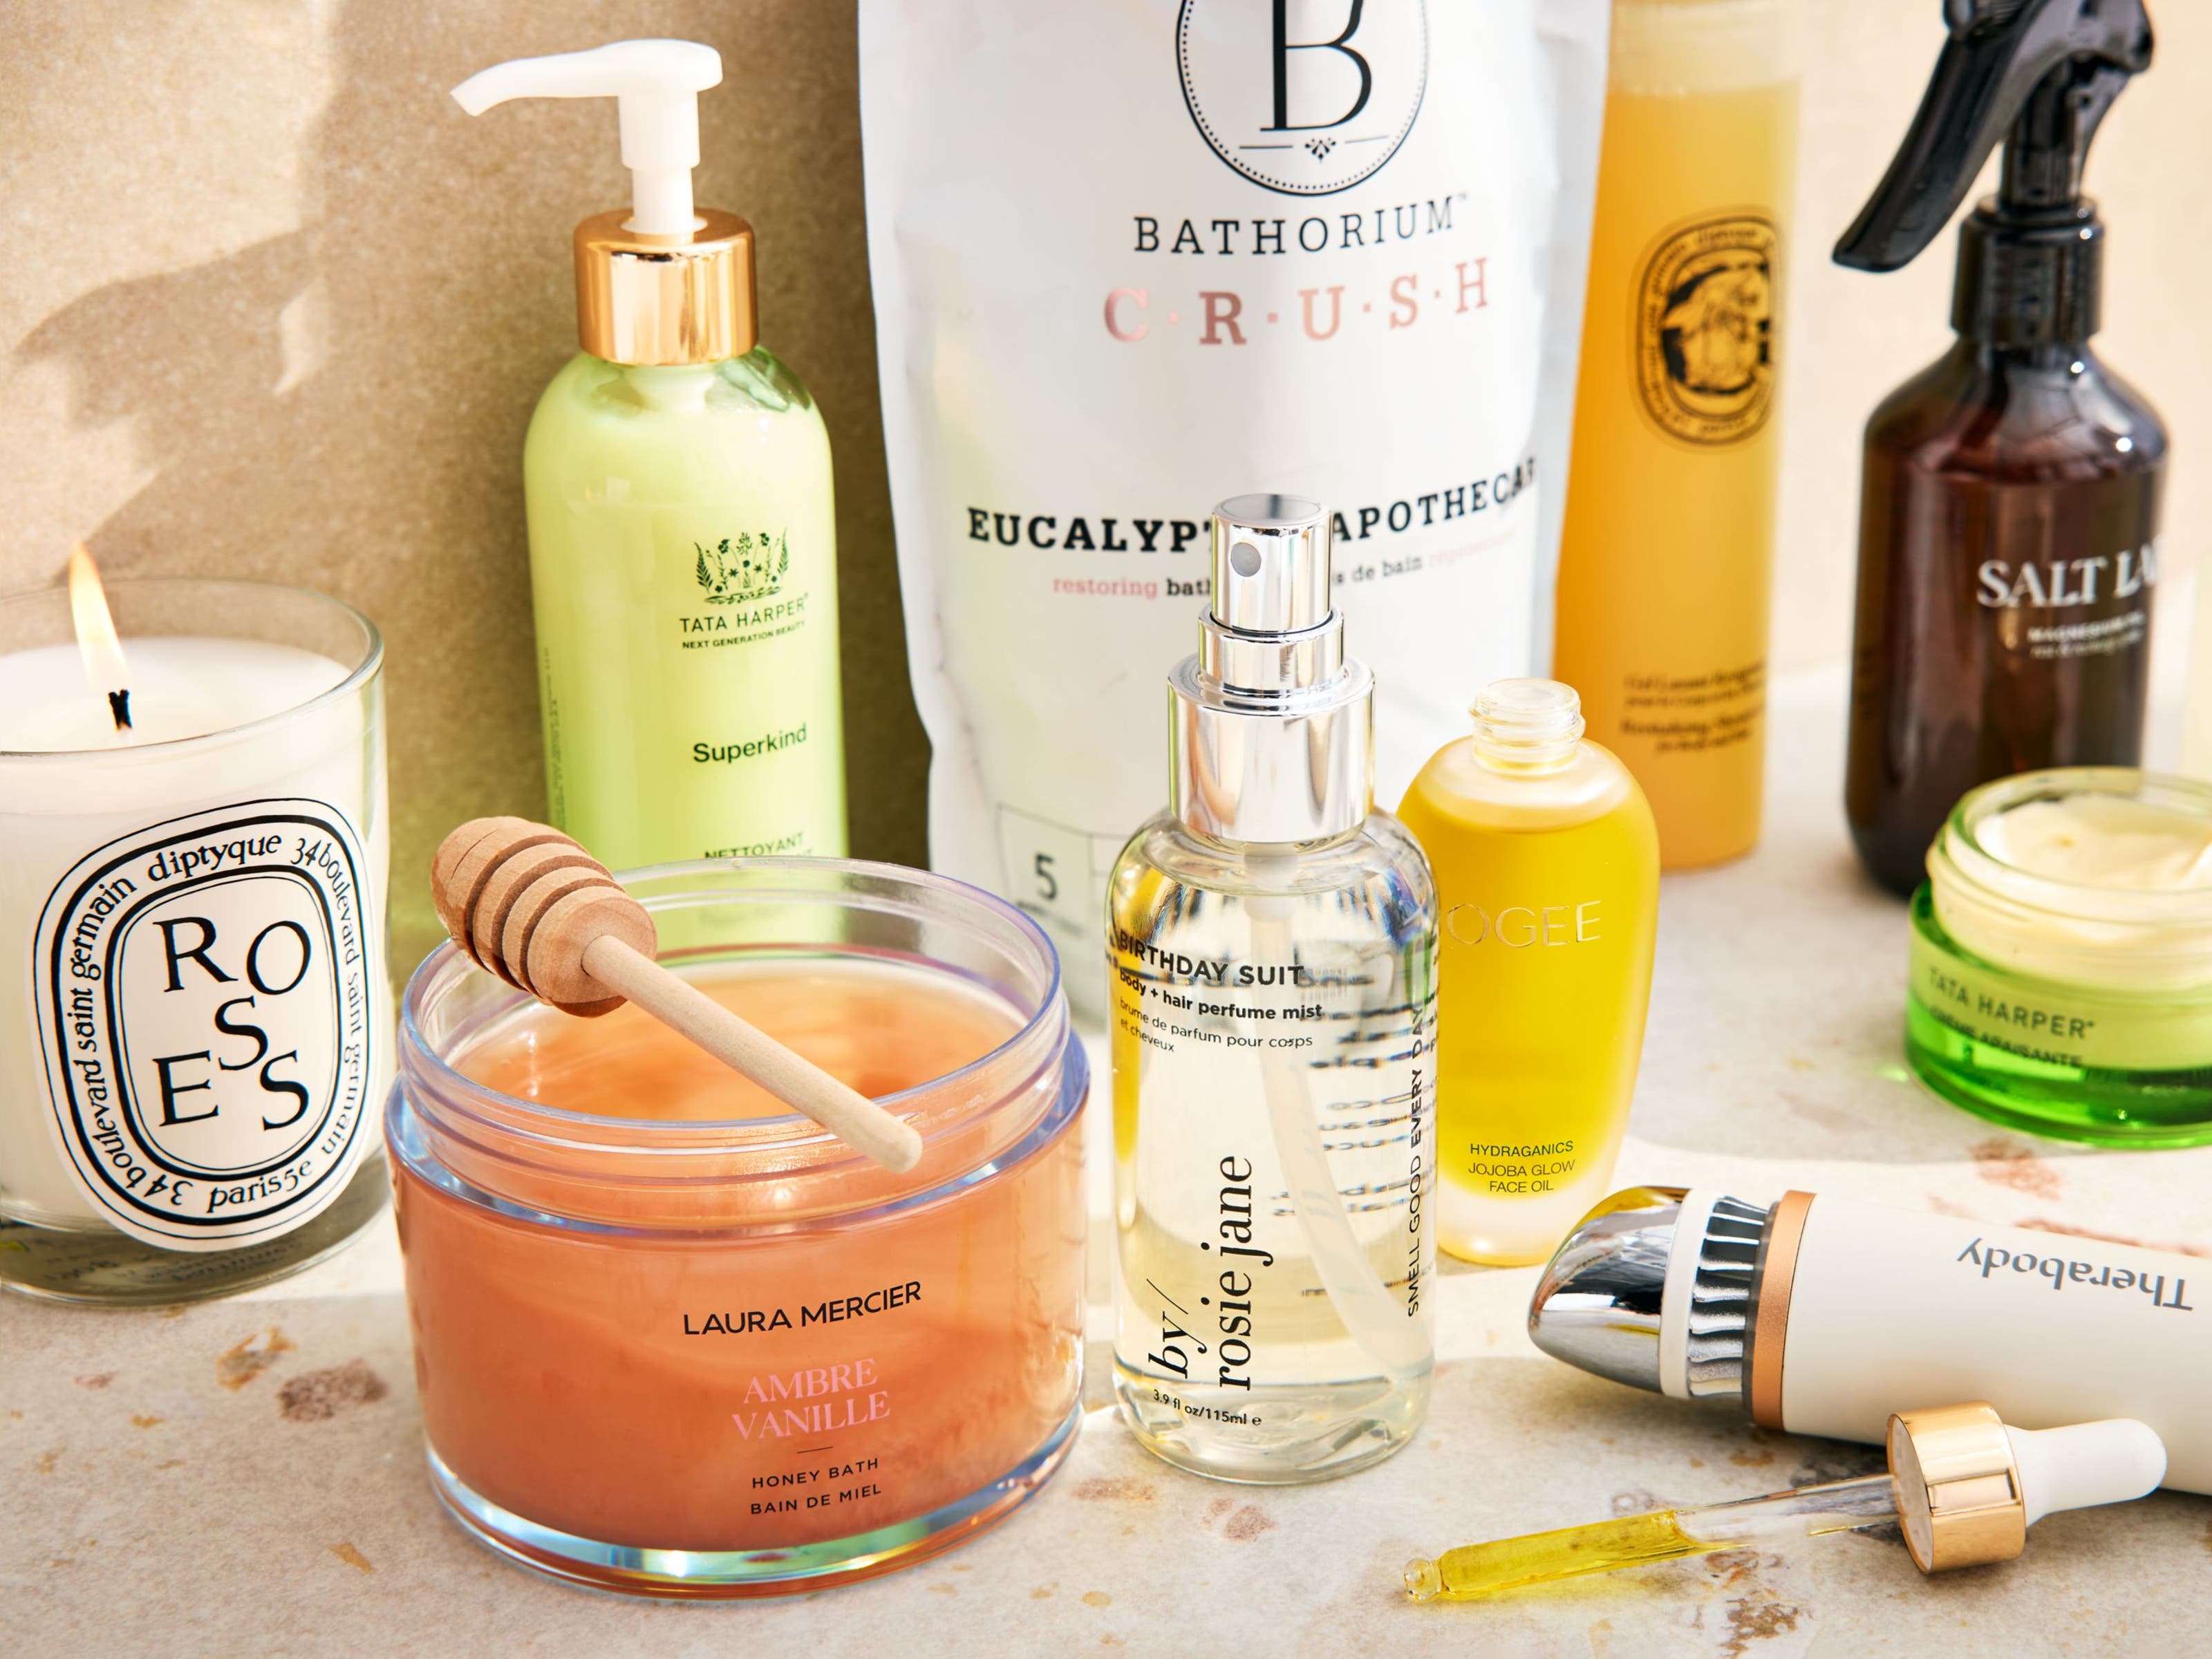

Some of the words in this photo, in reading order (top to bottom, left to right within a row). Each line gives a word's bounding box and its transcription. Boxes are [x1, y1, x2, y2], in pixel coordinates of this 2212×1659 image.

[1259, 0, 1371, 131] B
[1053, 577, 1158, 599] restoring
[1352, 565, 1375, 582] de
[1382, 556, 1423, 577] bain
[1976, 556, 2108, 608] SALT
[2114, 536, 2164, 599] LA
[679, 616, 727, 632] TATA
[682, 640, 709, 649] NEXT
[713, 631, 774, 648] GENERATION
[776, 621, 806, 637] BEAUTY
[693, 723, 807, 764] Superkind
[148, 834, 282, 881] diptyque
[1035, 852, 1058, 901] 5
[71, 875, 137, 980] germain
[1447, 900, 1602, 948] OGEE
[1118, 930, 1228, 982] BIRTHDAY
[1239, 965, 1304, 986] SUIT
[1120, 968, 1146, 996] body
[1163, 990, 1193, 1010] hair
[1199, 1001, 1276, 1020] perfume
[1283, 1003, 1322, 1020] mist
[1929, 968, 1969, 1006] TATA
[67, 987, 97, 1053] saint
[1120, 997, 1149, 1024] brume
[1152, 1016, 1167, 1031] de
[1171, 1024, 1221, 1044] parfum
[1227, 1036, 1264, 1051] pour
[1120, 1018, 1128, 1029] et
[1130, 1024, 1174, 1053] cheveux
[1412, 1006, 1424, 1060] DAY
[321, 1043, 360, 1155] germain
[1411, 1069, 1423, 1148] EVERY
[1468, 1162, 1527, 1177] JOJOBA
[1531, 1159, 1575, 1175] GLOW
[1470, 1141, 1573, 1157] HYDRAGANICS
[1200, 1155, 1274, 1267] jane
[1409, 1154, 1422, 1233] GOOD
[1490, 1181, 1526, 1193] FACE
[1531, 1179, 1555, 1192] OIL
[1408, 1239, 1421, 1318] SMELL
[1956, 1237, 2193, 1311] Therabody
[683, 1309, 792, 1335] LAURA
[801, 1281, 921, 1327] MERCIER
[1199, 1270, 1253, 1391] rosie
[742, 1358, 878, 1404] AMBRE
[1153, 1389, 1170, 1405] 3.9
[1172, 1398, 1181, 1410] fl
[731, 1390, 892, 1441] VANILLE
[751, 1499, 798, 1515] BAIN
[807, 1494, 831, 1509] DE
[839, 1483, 882, 1503] MIEL
[752, 1470, 821, 1490] HONEY
[829, 1457, 879, 1479] BATH
